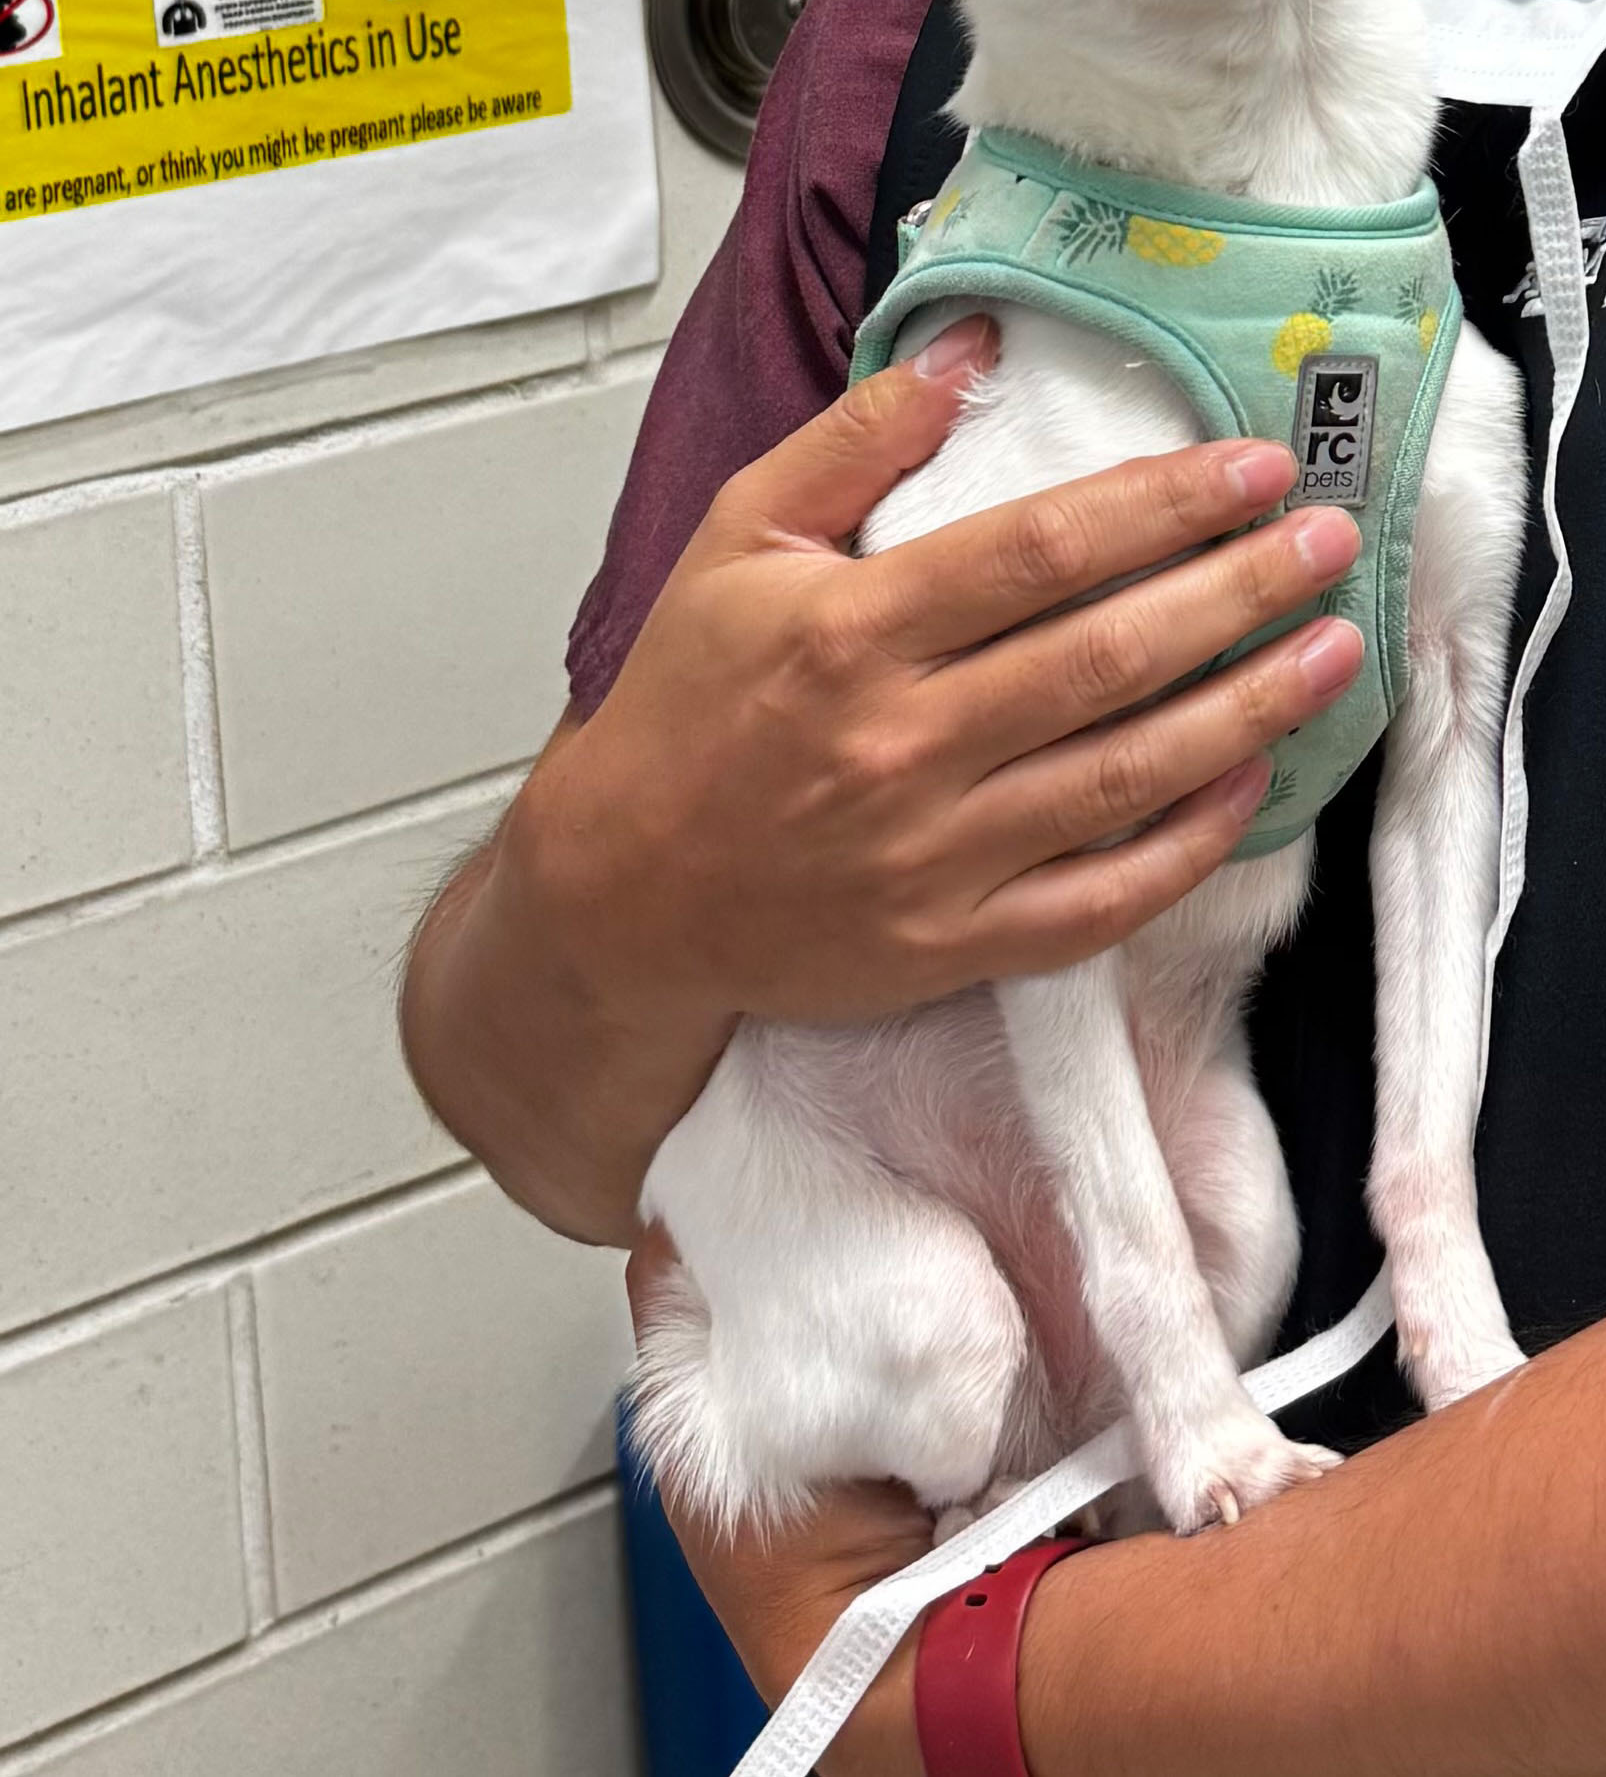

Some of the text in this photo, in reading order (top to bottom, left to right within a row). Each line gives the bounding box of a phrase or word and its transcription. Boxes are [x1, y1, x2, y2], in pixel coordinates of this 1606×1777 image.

[22, 13, 462, 133] Inhalant Anesthetics in Use
[5, 89, 542, 212] are pregnant, or think you might be pregnant please be aware
[1302, 468, 1354, 494] pets
[1305, 430, 1357, 467] rc
